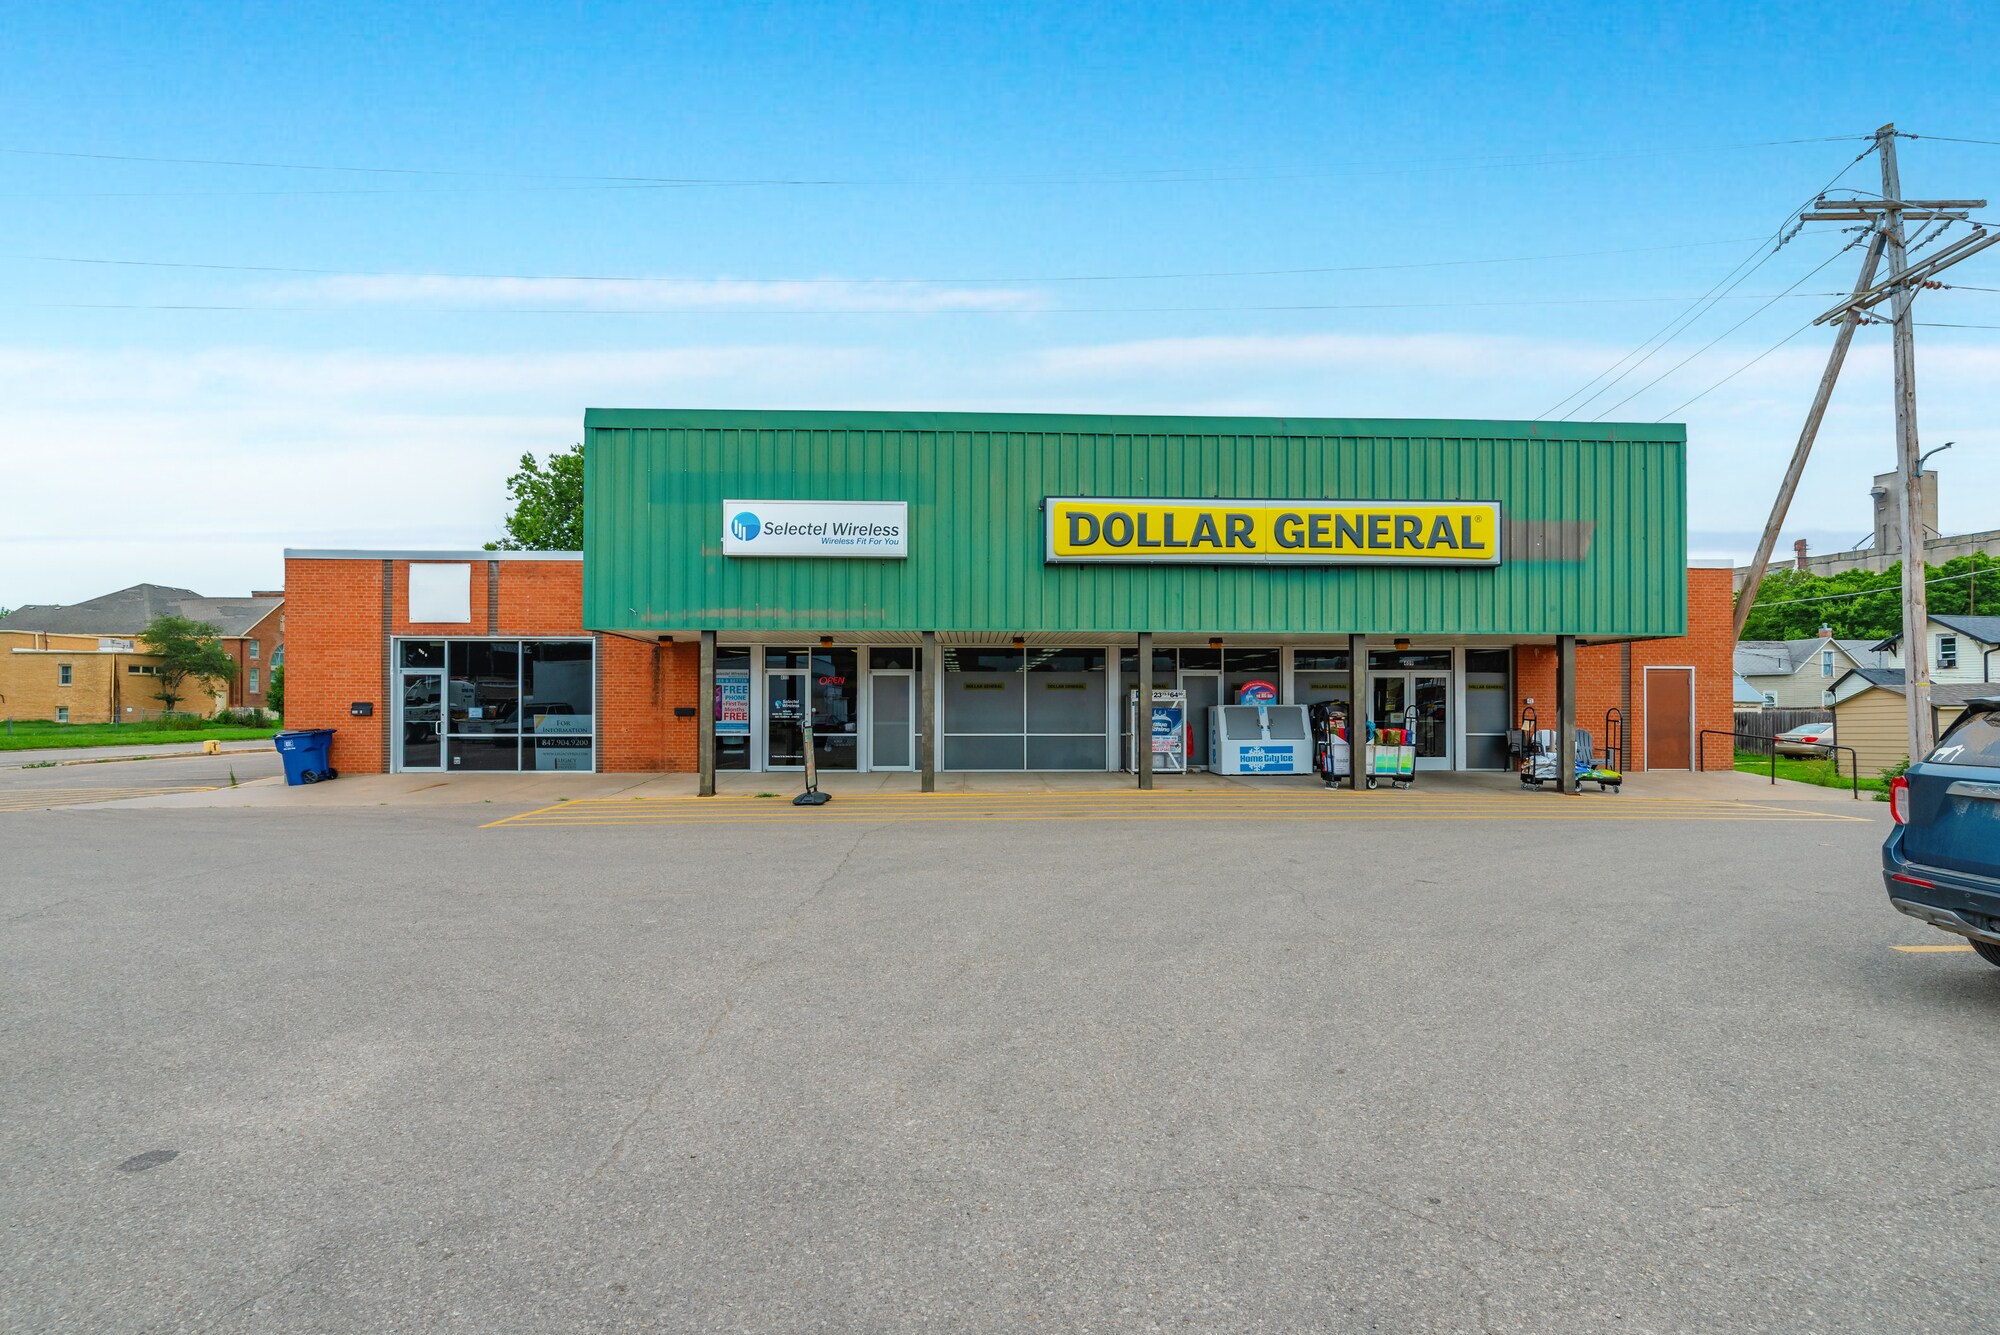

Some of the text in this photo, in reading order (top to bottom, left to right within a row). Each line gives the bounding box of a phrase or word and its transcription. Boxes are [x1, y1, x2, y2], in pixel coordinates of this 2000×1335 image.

[763, 521, 900, 537] Selectel Wireless
[1065, 510, 1486, 550] DOLLAR GENERAL
[821, 537, 855, 545] Wireless
[856, 537, 867, 545] Fit
[884, 538, 900, 546] You
[818, 676, 846, 686] OPEN
[723, 685, 748, 694] FREE
[723, 712, 748, 721] FREE
[1240, 754, 1294, 763] Home City Ice
